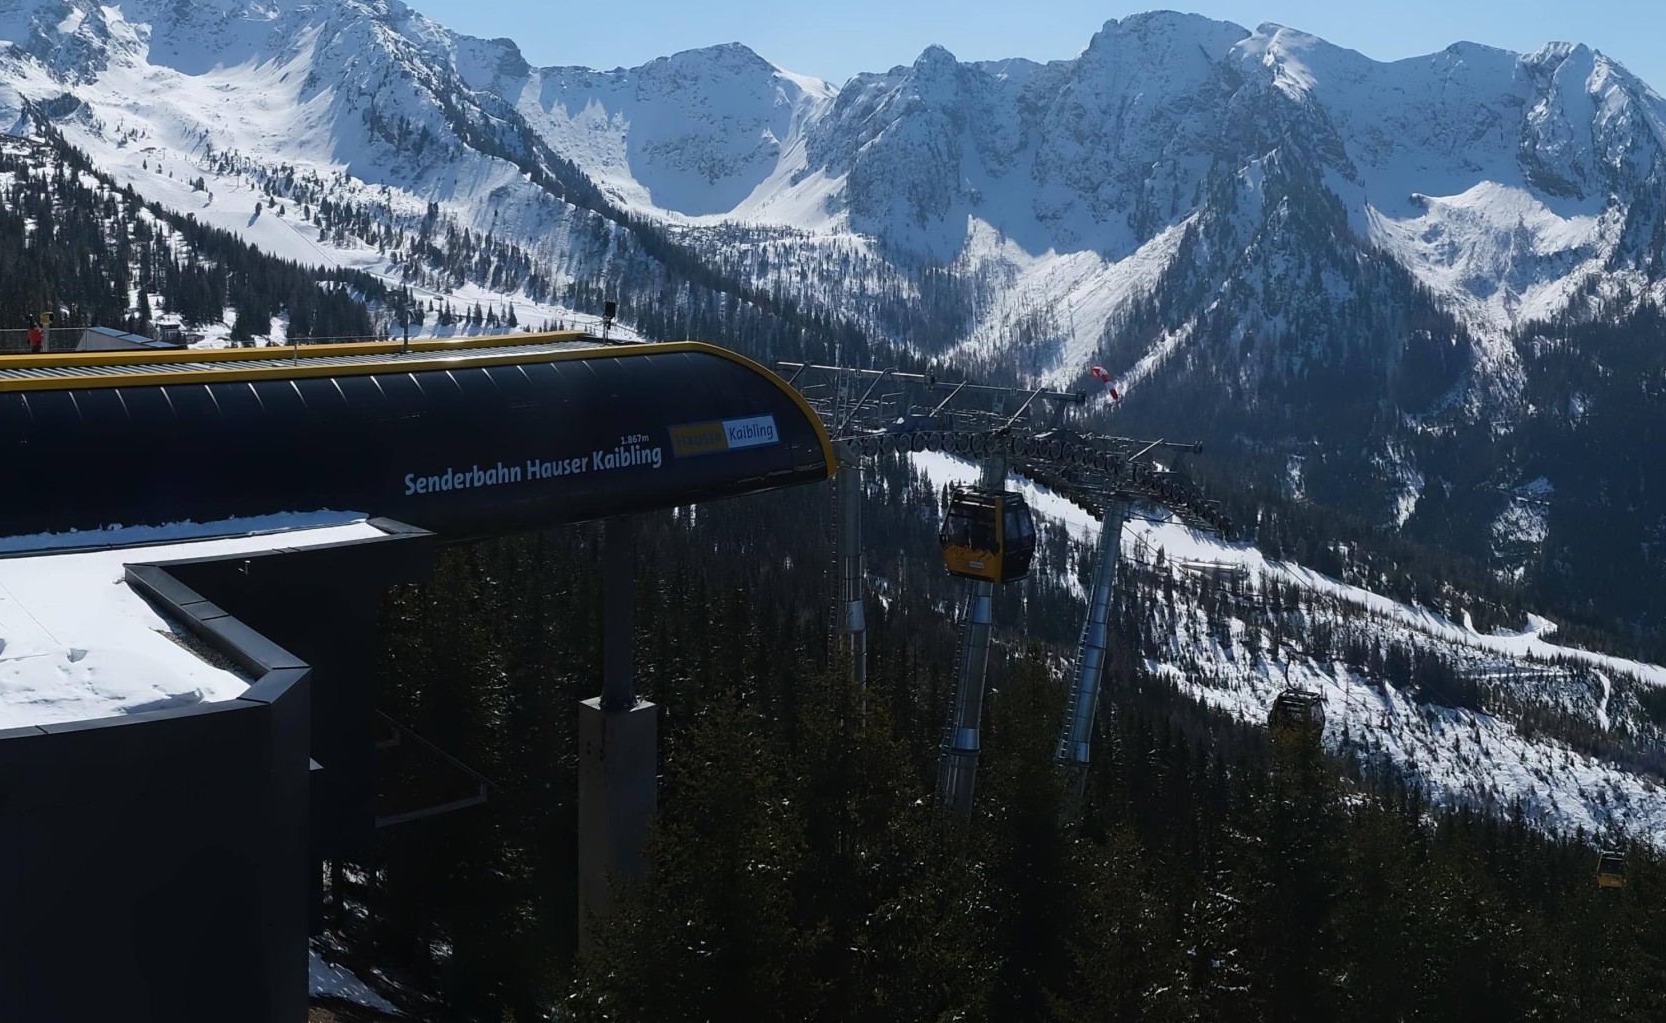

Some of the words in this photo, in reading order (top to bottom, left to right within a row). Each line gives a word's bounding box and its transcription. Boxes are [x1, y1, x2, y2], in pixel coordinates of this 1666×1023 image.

[620, 433, 650, 445] 1.867m
[729, 424, 774, 442] Kaibling
[404, 461, 522, 496] Senderbahn
[526, 451, 590, 480] Hauser
[592, 443, 662, 471] Kaibling
